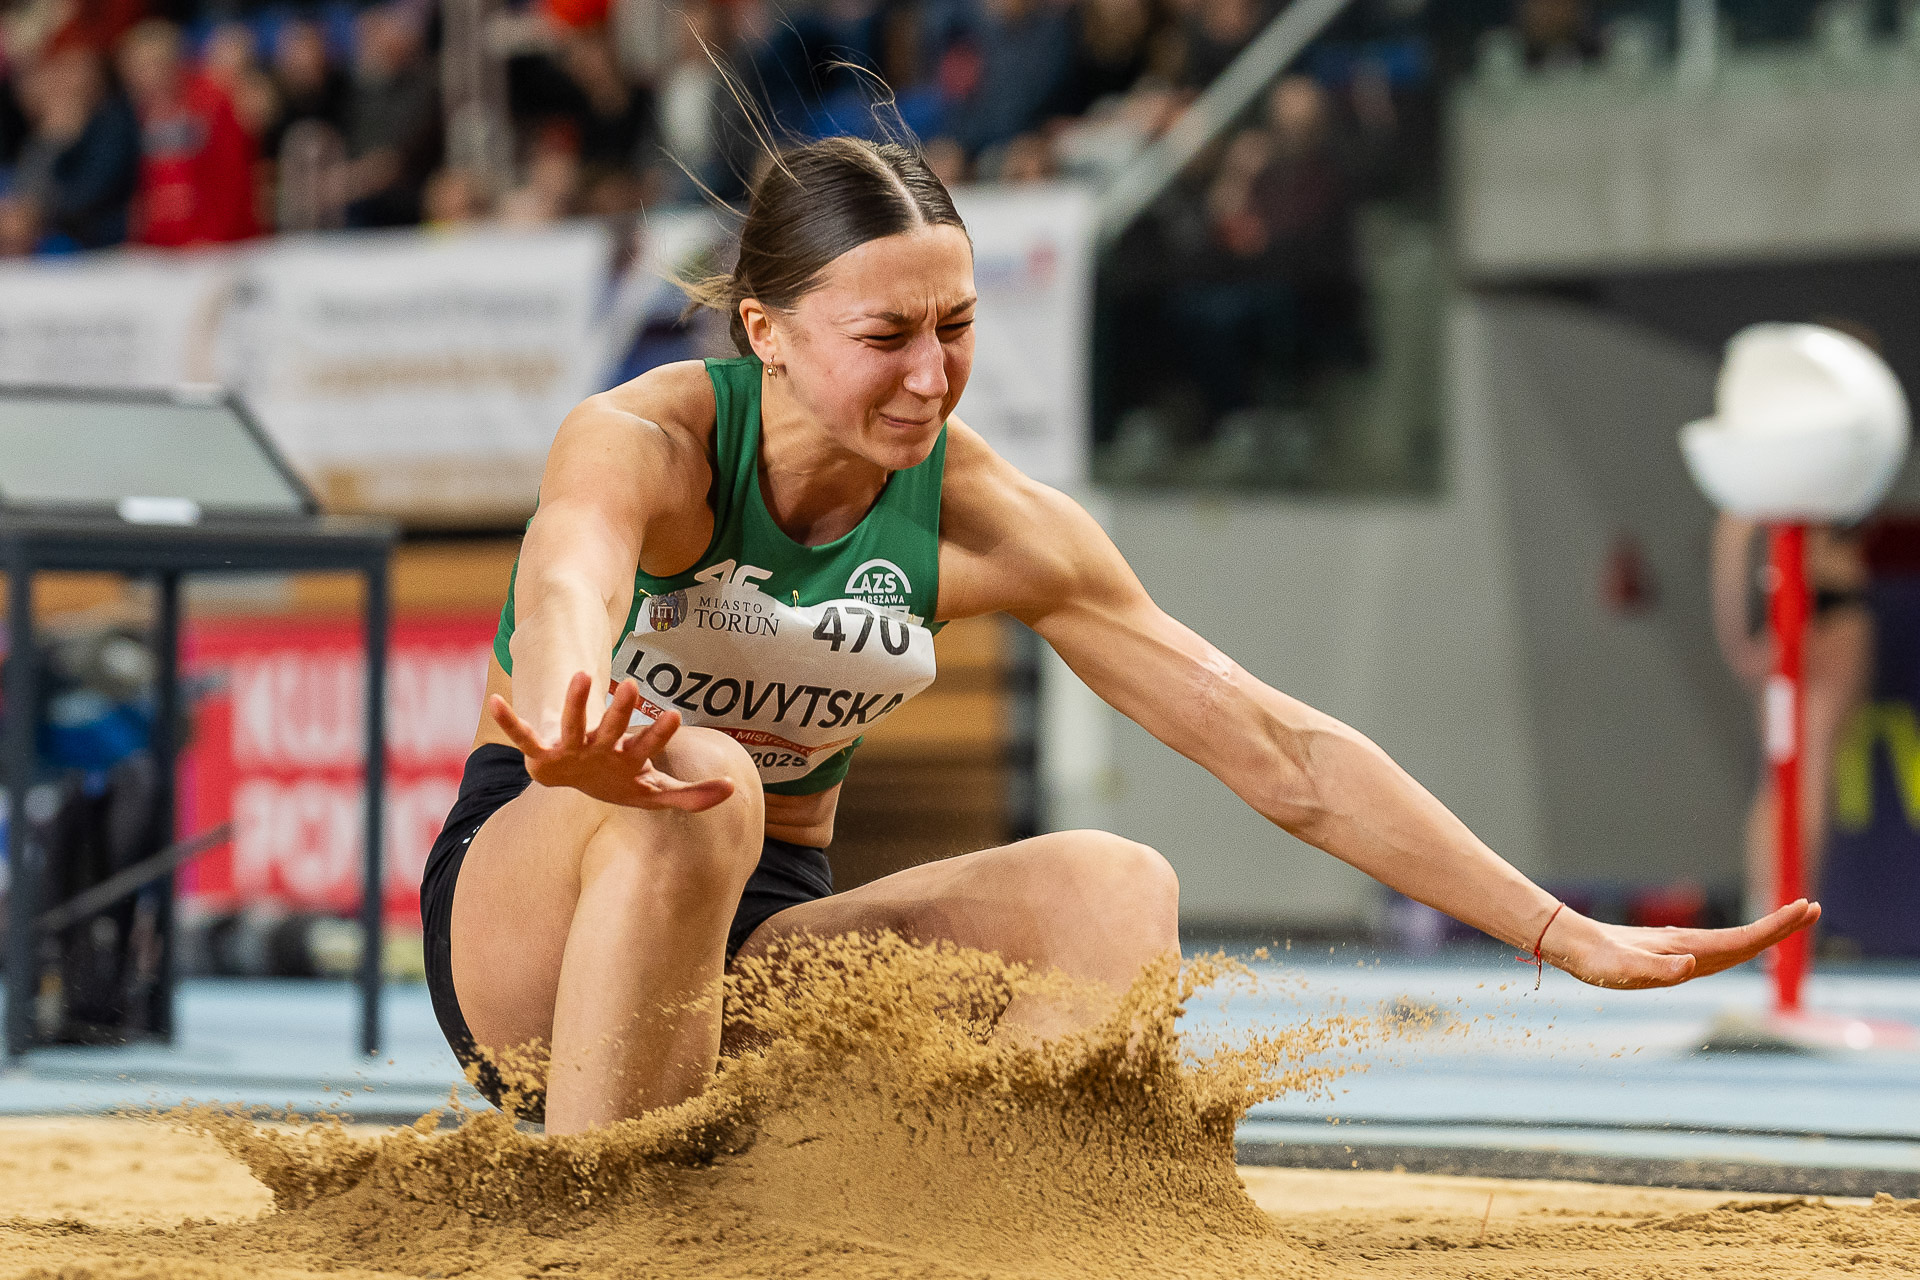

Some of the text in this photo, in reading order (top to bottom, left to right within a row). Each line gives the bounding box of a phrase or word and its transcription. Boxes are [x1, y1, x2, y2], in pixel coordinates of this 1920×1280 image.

[860, 572, 897, 594] AZS
[699, 596, 763, 614] MIASTO
[853, 594, 905, 604] WARSZAWA
[693, 608, 780, 637] TORUŃ
[812, 606, 910, 656] 470
[625, 649, 904, 728] LOZOVYTSKA
[750, 751, 807, 769] 2025
